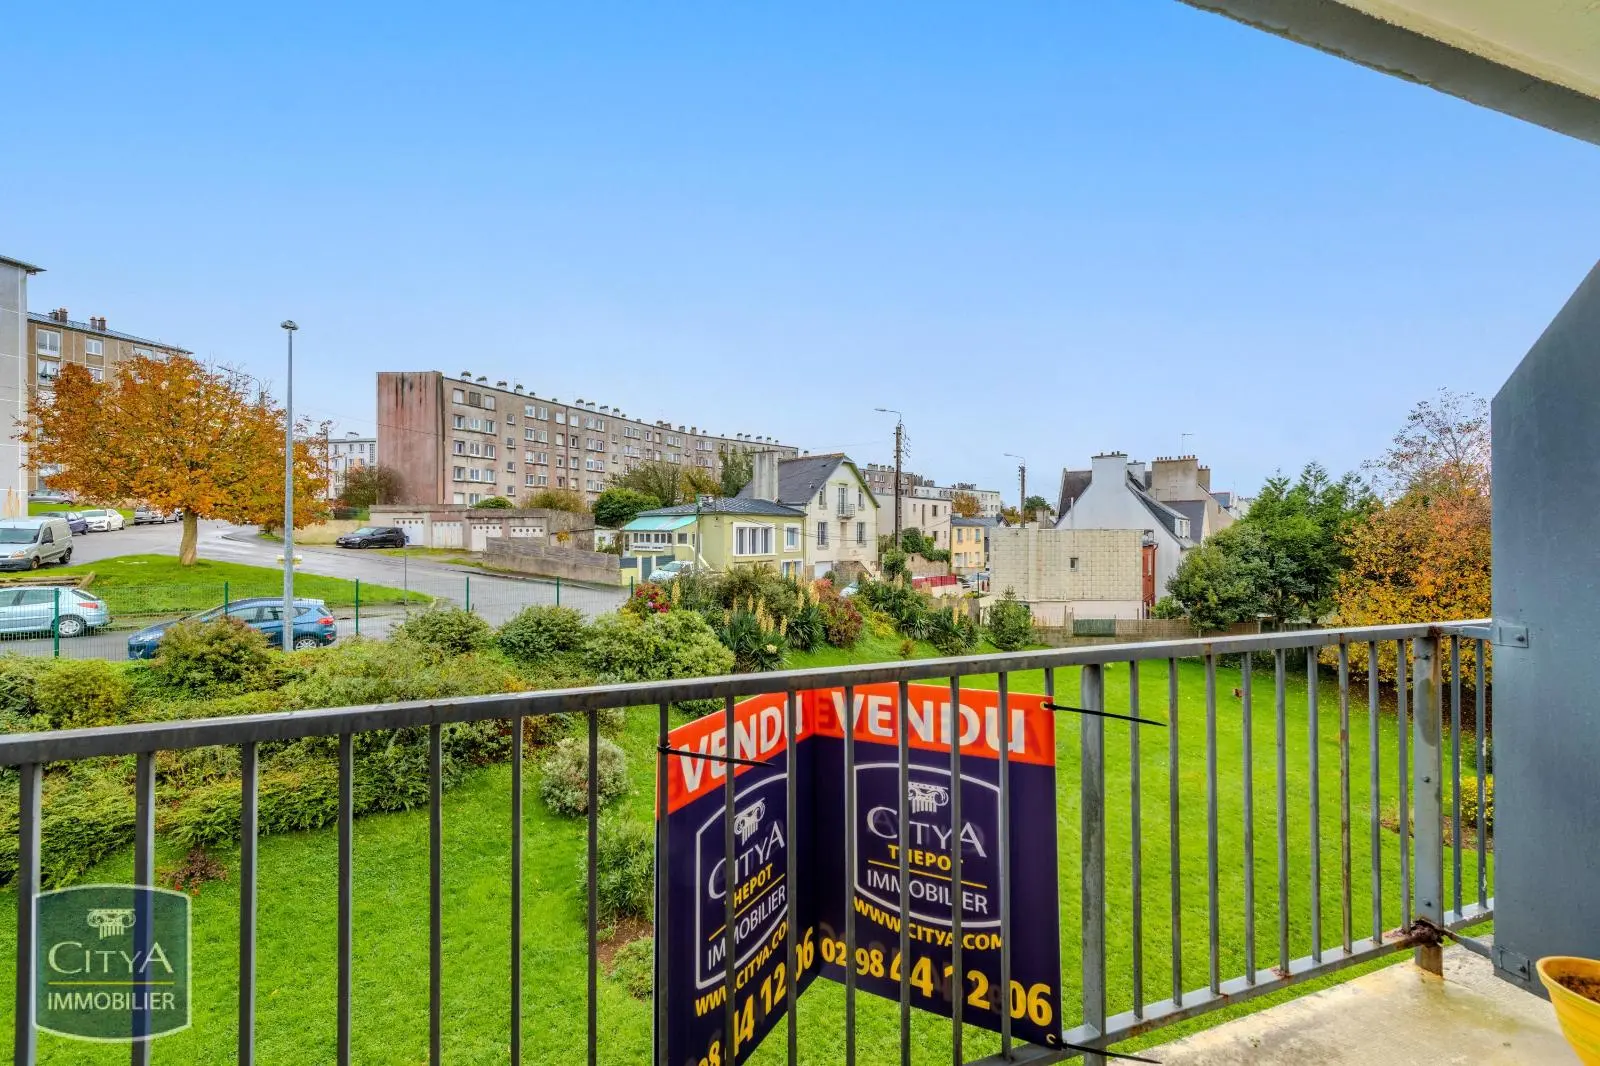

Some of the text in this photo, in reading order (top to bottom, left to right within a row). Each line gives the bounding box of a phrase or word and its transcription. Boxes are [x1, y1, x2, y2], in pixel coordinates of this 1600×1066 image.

[679, 693, 804, 793] VENDU
[831, 691, 1026, 754] VENDU
[866, 806, 988, 858] CTYA
[887, 844, 964, 871] TEPO
[725, 863, 773, 908] HEPOT
[866, 869, 989, 914] IMMOBILER
[760, 962, 787, 1015] 12
[821, 938, 847, 967] 02
[855, 948, 885, 978] 98
[1009, 980, 1053, 1027] 06
